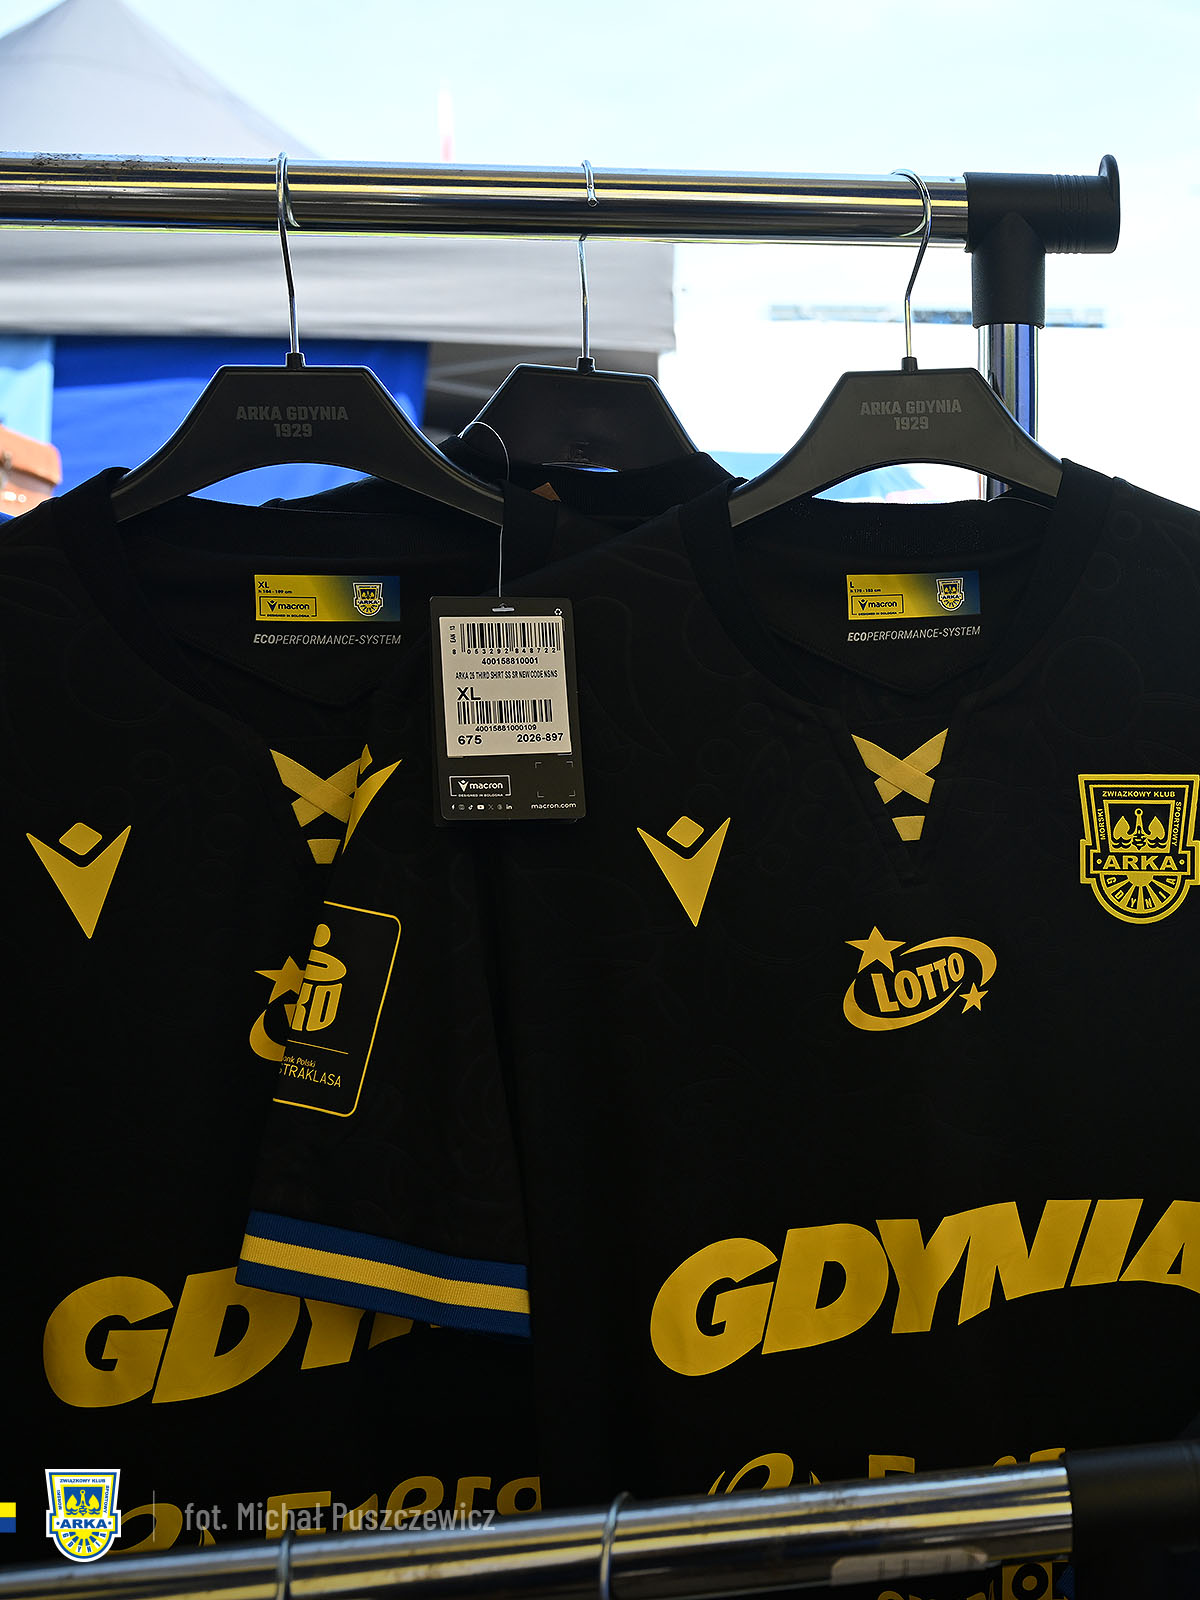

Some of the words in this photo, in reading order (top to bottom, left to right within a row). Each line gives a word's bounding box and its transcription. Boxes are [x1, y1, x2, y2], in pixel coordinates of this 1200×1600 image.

[236, 406, 282, 420] ARKA
[286, 406, 349, 420] GDYNIA
[860, 402, 902, 415] ARKA
[905, 400, 962, 414] GDYNIA
[274, 423, 313, 438] 1929
[894, 416, 929, 430] 1929
[253, 633, 401, 645] ECOPERFORMANCE-SYSTEM
[848, 626, 981, 642] ECOPERFORMANCE-SYSTEM
[482, 657, 538, 665] 400158810001
[457, 687, 481, 700] XL
[458, 735, 482, 745] 675
[517, 733, 563, 742] 2026-897
[1154, 790, 1176, 798] KLUB
[1097, 808, 1106, 840] MORSKI
[1171, 801, 1182, 846] SPORTOWY
[1102, 855, 1179, 870] ARKA
[1106, 876, 1176, 908] GDYNIA
[871, 952, 965, 1012] LOTTO
